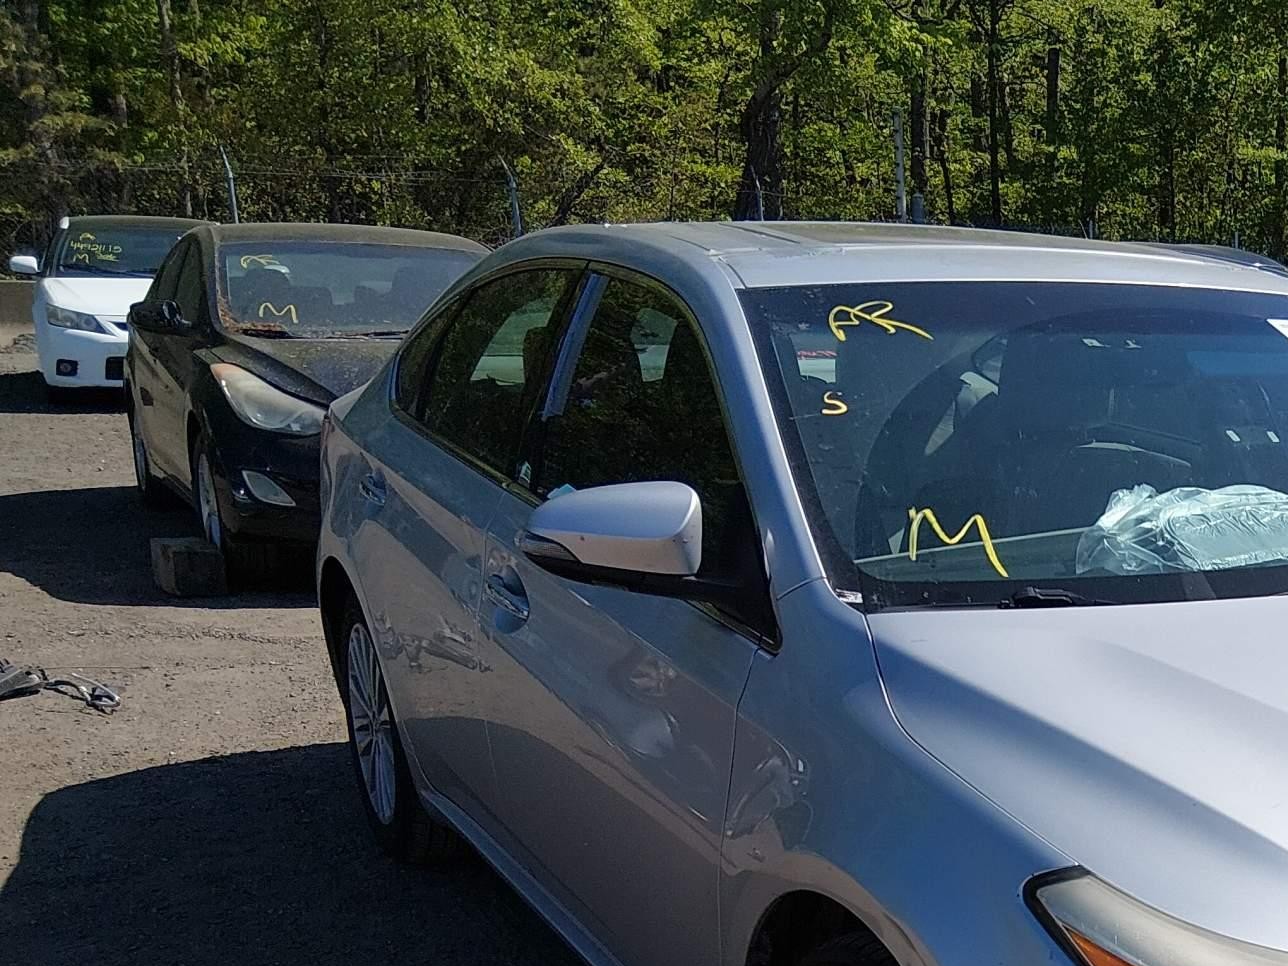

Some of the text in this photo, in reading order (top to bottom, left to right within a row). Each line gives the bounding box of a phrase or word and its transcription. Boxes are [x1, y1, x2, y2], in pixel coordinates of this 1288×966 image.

[258, 302, 299, 324] M
[821, 391, 848, 415] S
[908, 506, 1009, 578] M
